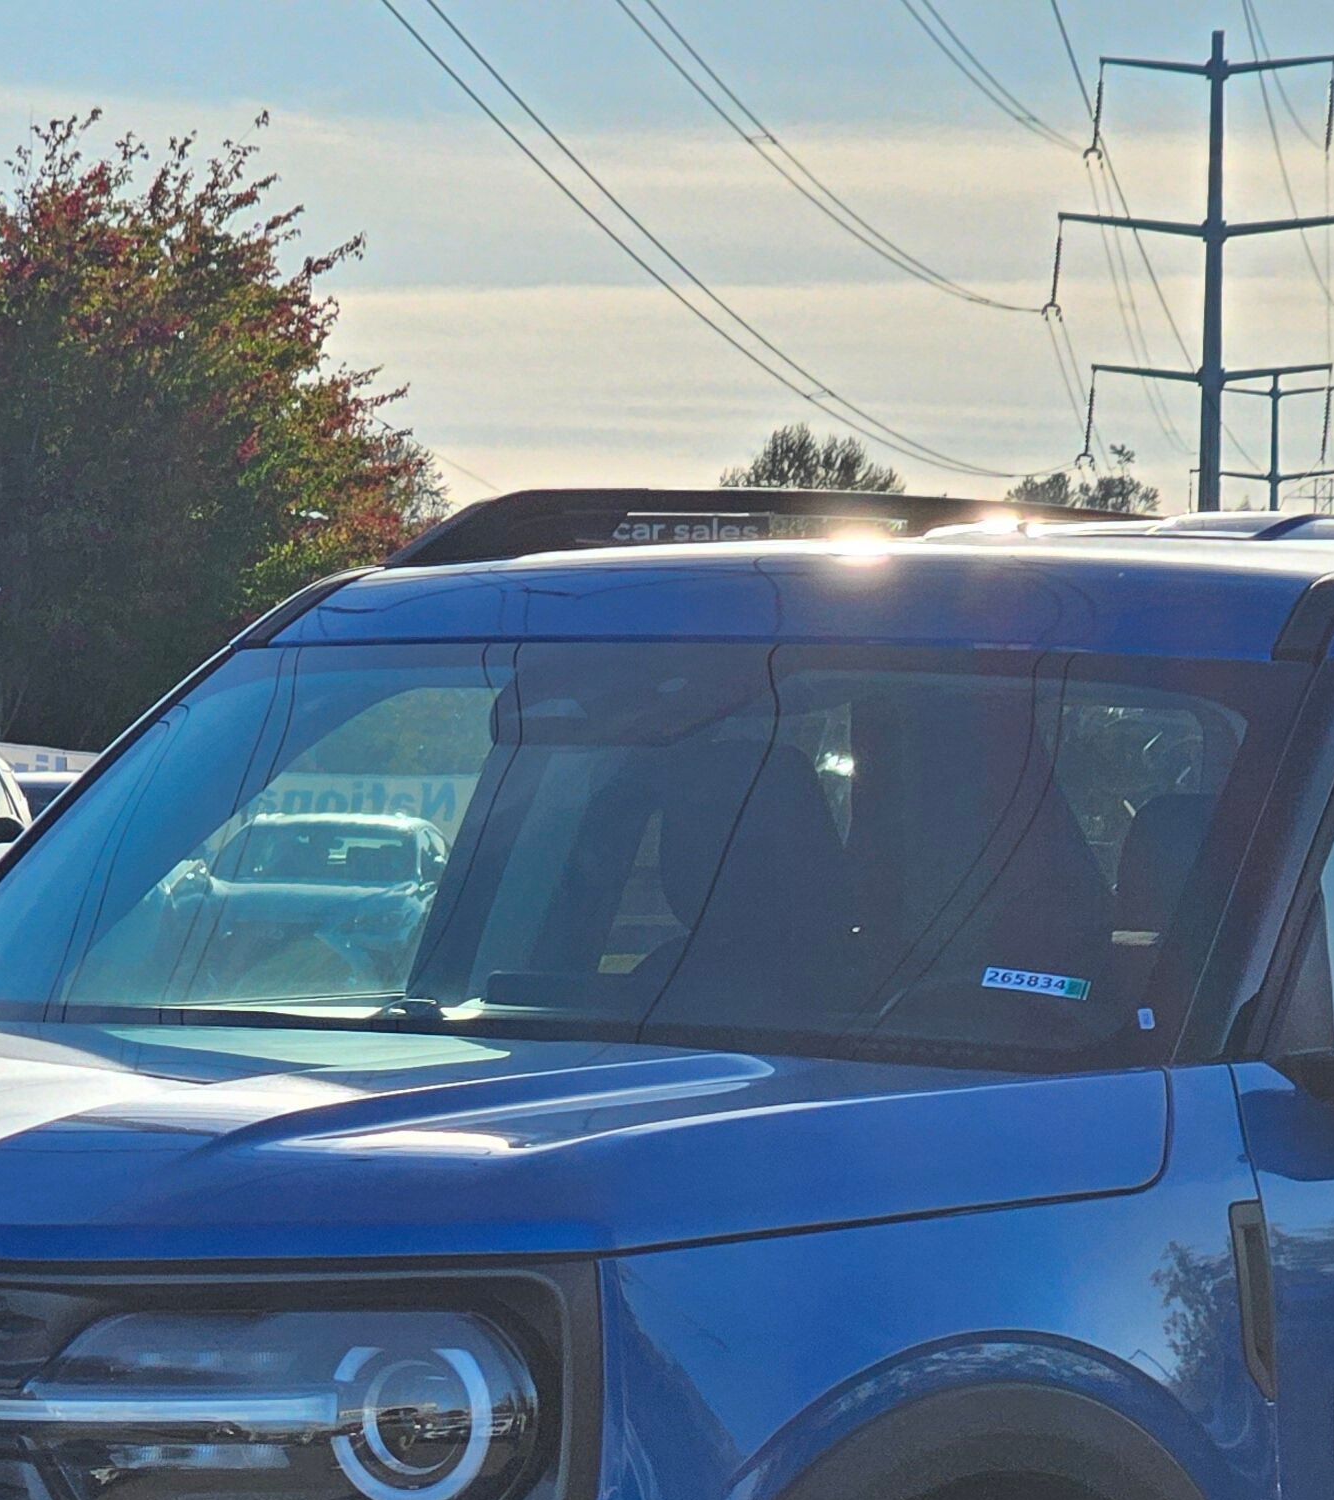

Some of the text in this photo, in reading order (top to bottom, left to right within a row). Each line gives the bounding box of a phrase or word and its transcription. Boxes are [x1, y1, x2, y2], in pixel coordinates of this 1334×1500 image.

[612, 517, 759, 541] car sales
[987, 969, 1066, 990] 265834
